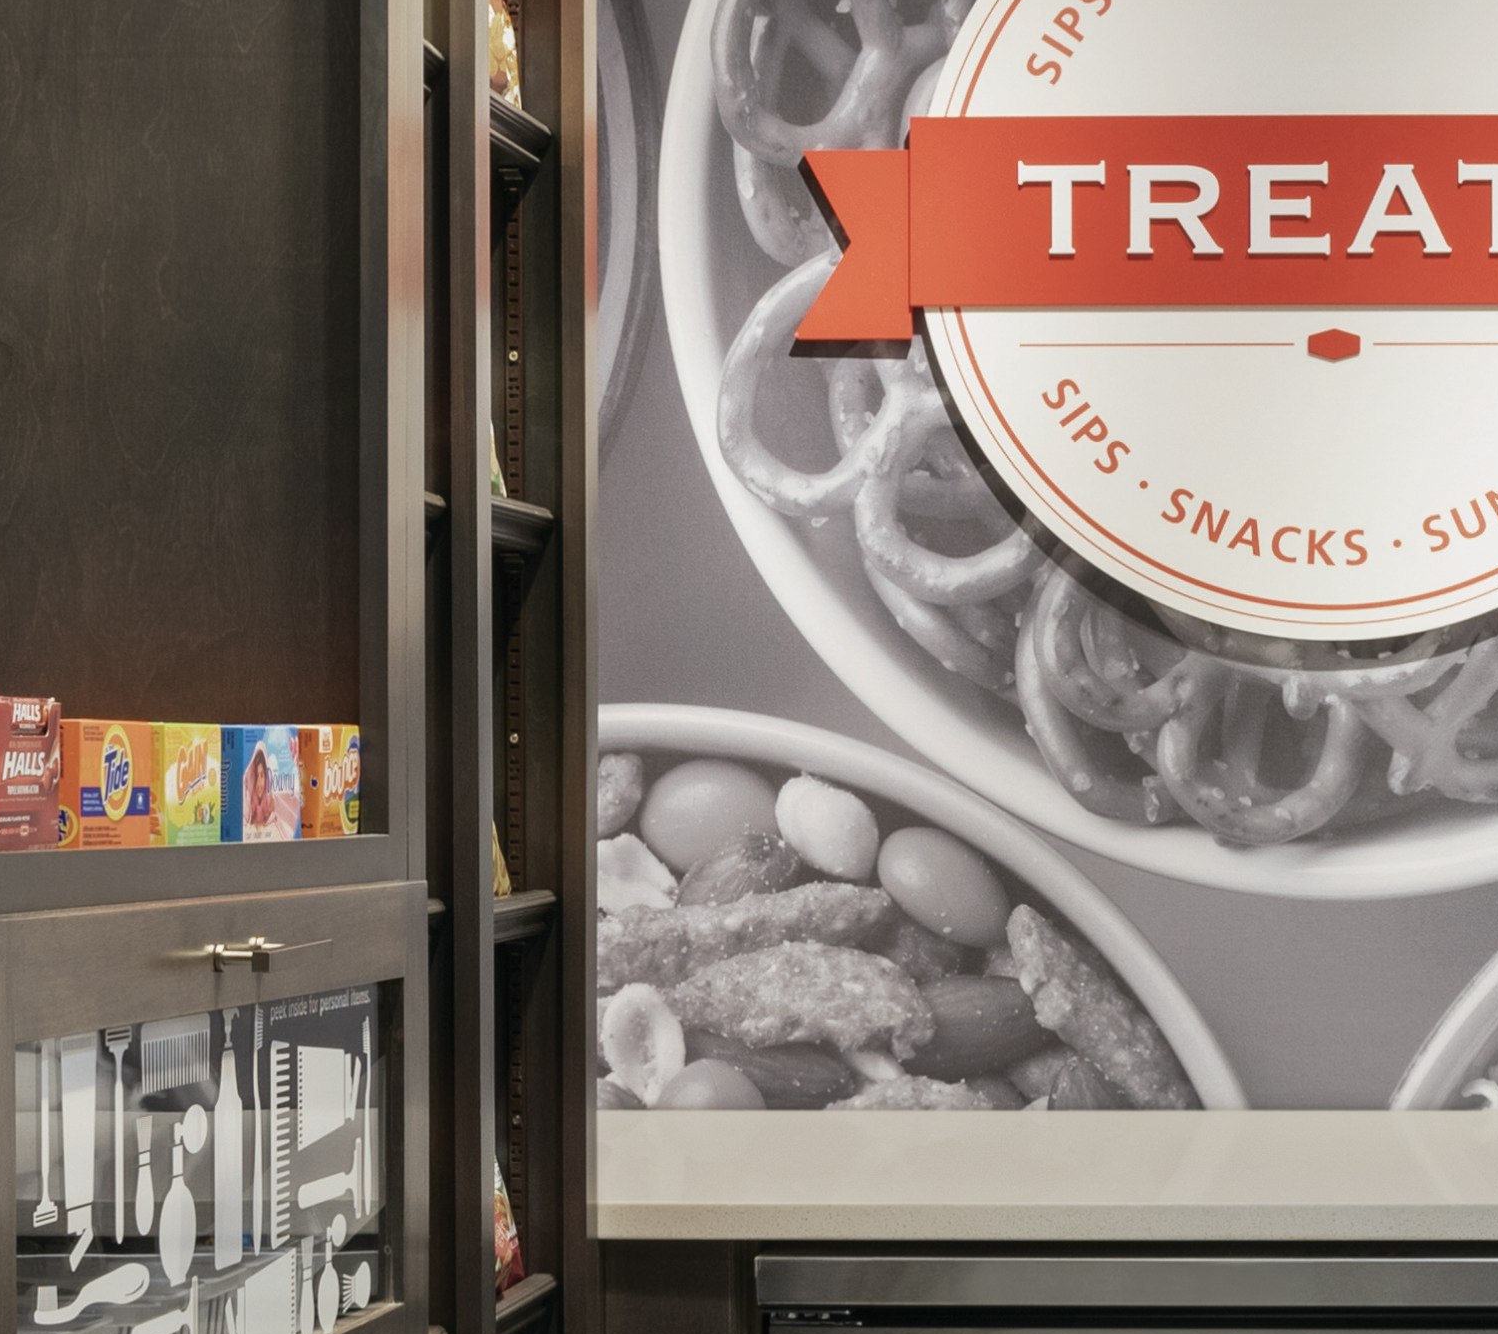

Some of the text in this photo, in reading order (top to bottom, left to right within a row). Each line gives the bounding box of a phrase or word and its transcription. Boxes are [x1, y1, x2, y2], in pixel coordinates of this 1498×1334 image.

[1042, 378, 1130, 478] SIPS
[1160, 487, 1369, 568] SNACKS
[12, 702, 42, 724] HALLS
[3, 750, 46, 781] HALLS
[102, 748, 131, 805] Tide
[267, 767, 295, 797] Downy
[270, 988, 372, 1025] peek inside for personal items.
